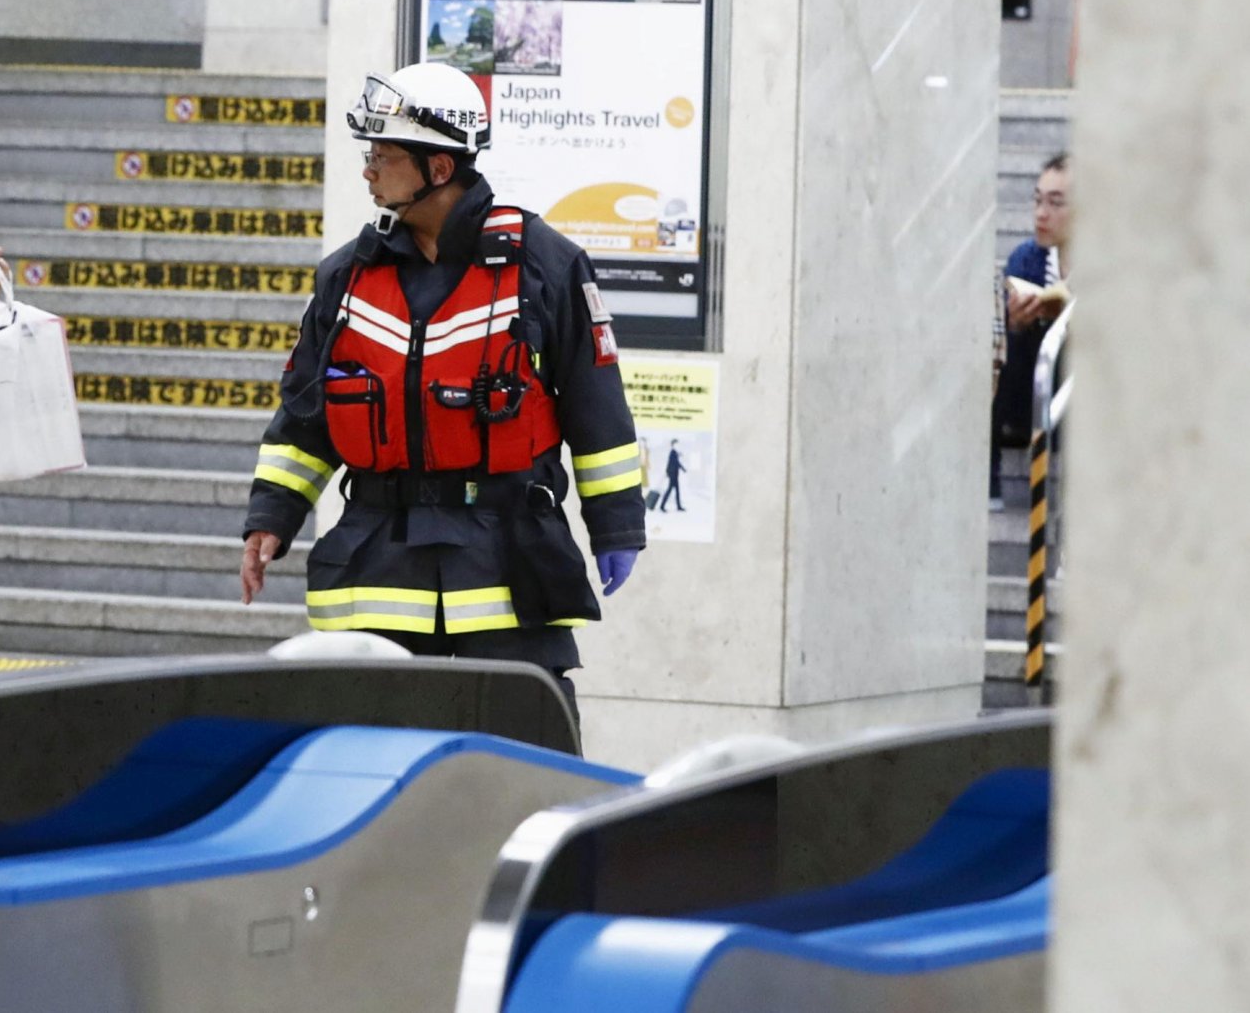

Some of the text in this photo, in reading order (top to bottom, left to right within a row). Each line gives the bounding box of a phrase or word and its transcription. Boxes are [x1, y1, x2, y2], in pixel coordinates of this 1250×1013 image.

[501, 83, 560, 102] Japan
[500, 109, 595, 129] Highlights
[603, 111, 659, 127] Travel
